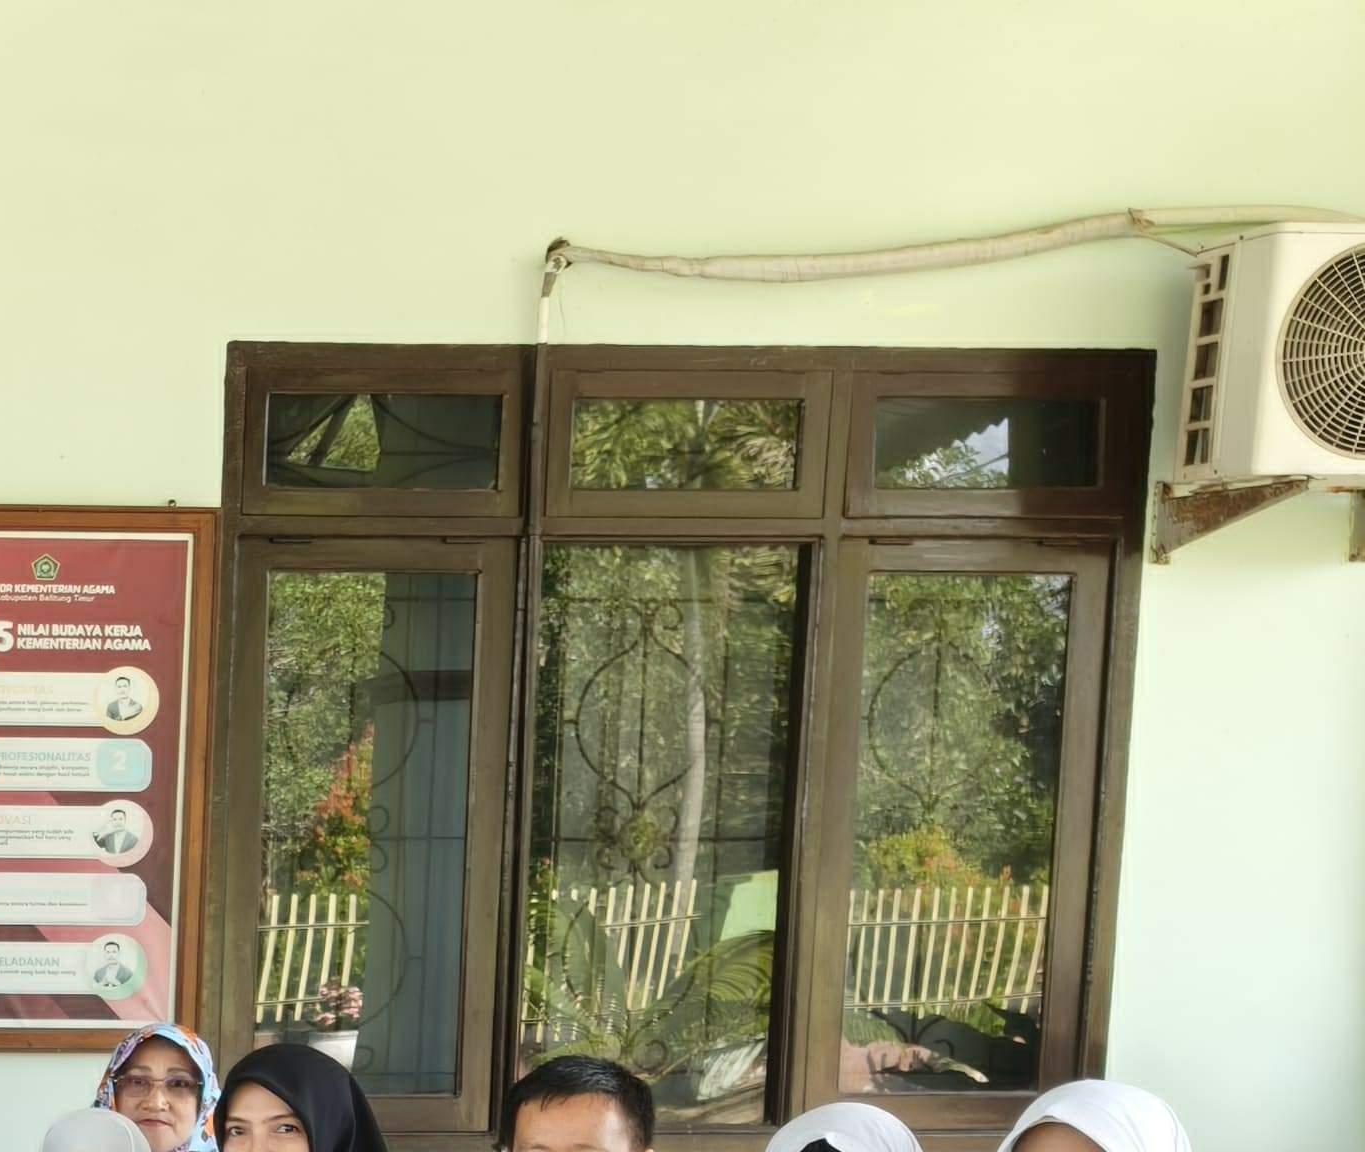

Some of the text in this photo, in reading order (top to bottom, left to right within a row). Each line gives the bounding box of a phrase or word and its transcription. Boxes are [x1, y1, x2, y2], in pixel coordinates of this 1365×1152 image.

[14, 583, 82, 594] KEMENTERIAN
[82, 584, 116, 595] AGAMA
[17, 624, 144, 638] NILAI BUDAYA KERJA
[17, 637, 152, 651] KEMENTERIAN AGAMA
